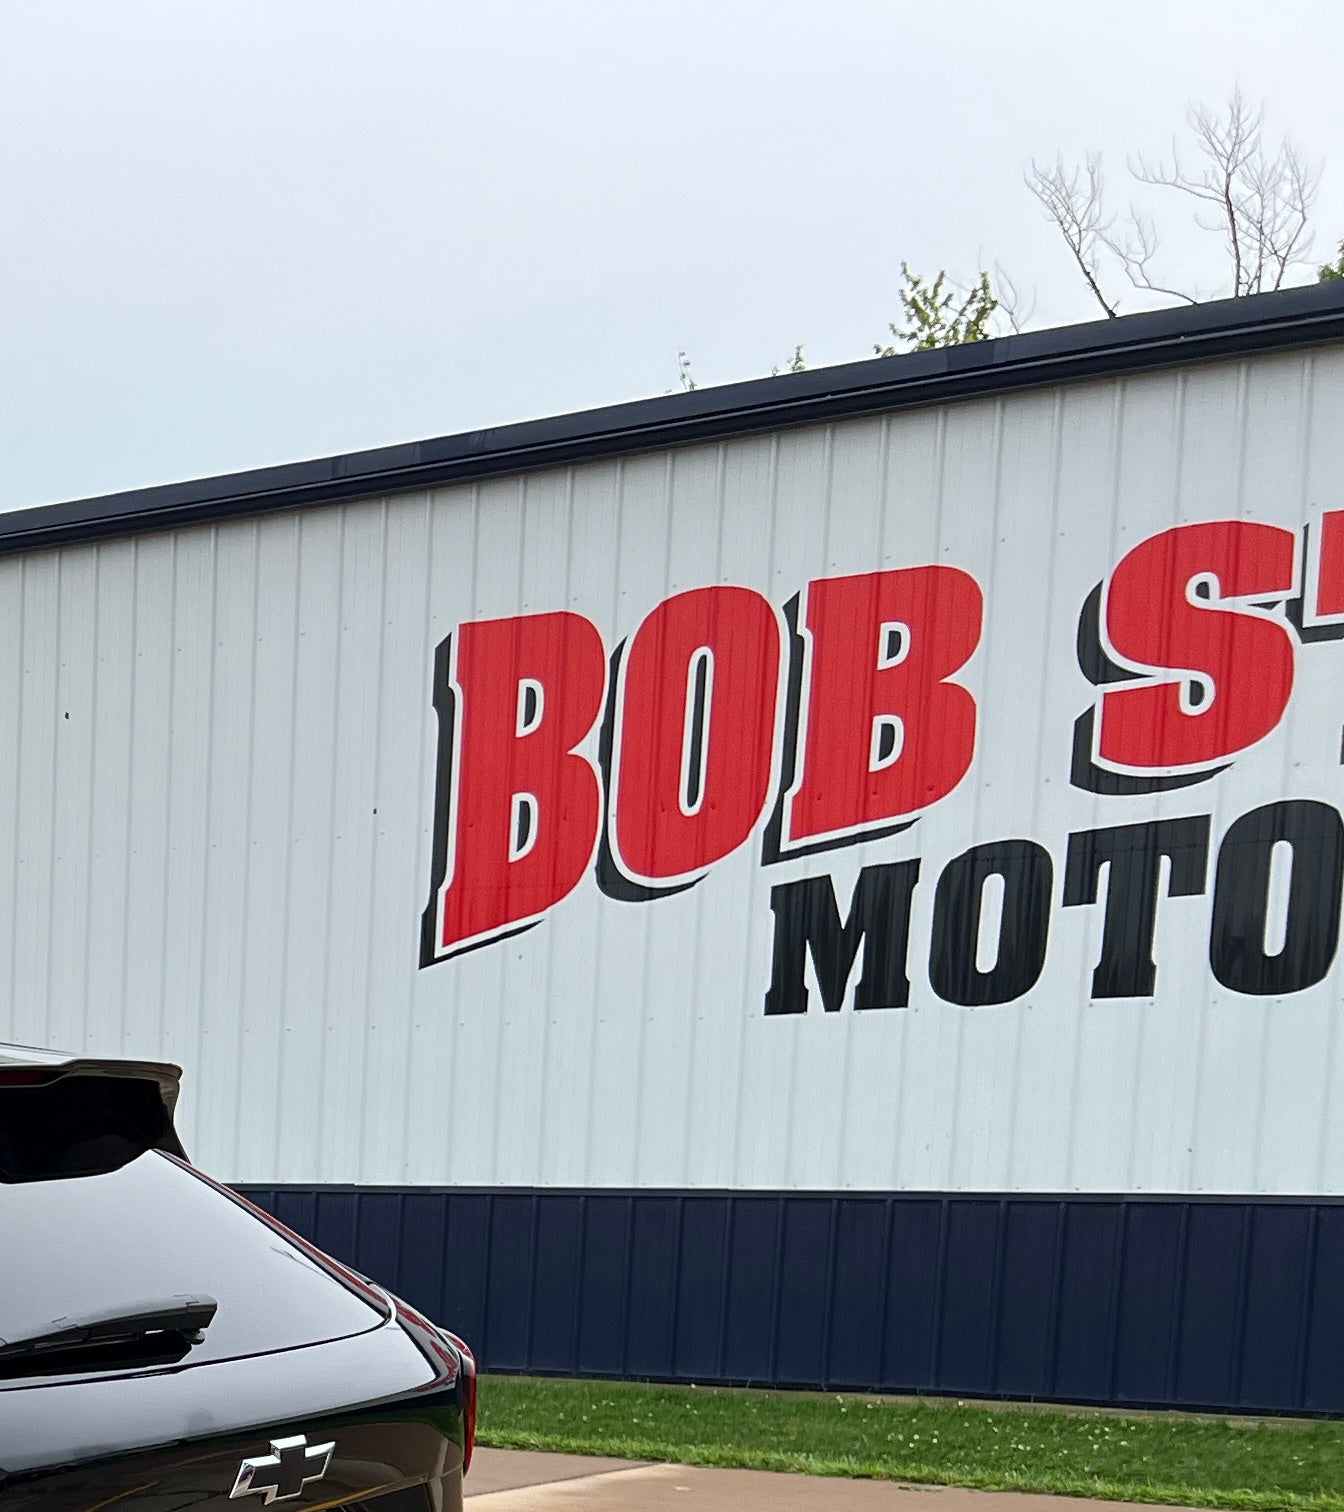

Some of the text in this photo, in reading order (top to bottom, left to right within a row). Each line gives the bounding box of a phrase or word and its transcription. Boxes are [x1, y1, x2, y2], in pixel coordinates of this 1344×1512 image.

[420, 508, 1344, 969] BOB S
[765, 799, 1343, 1018] MOTO
